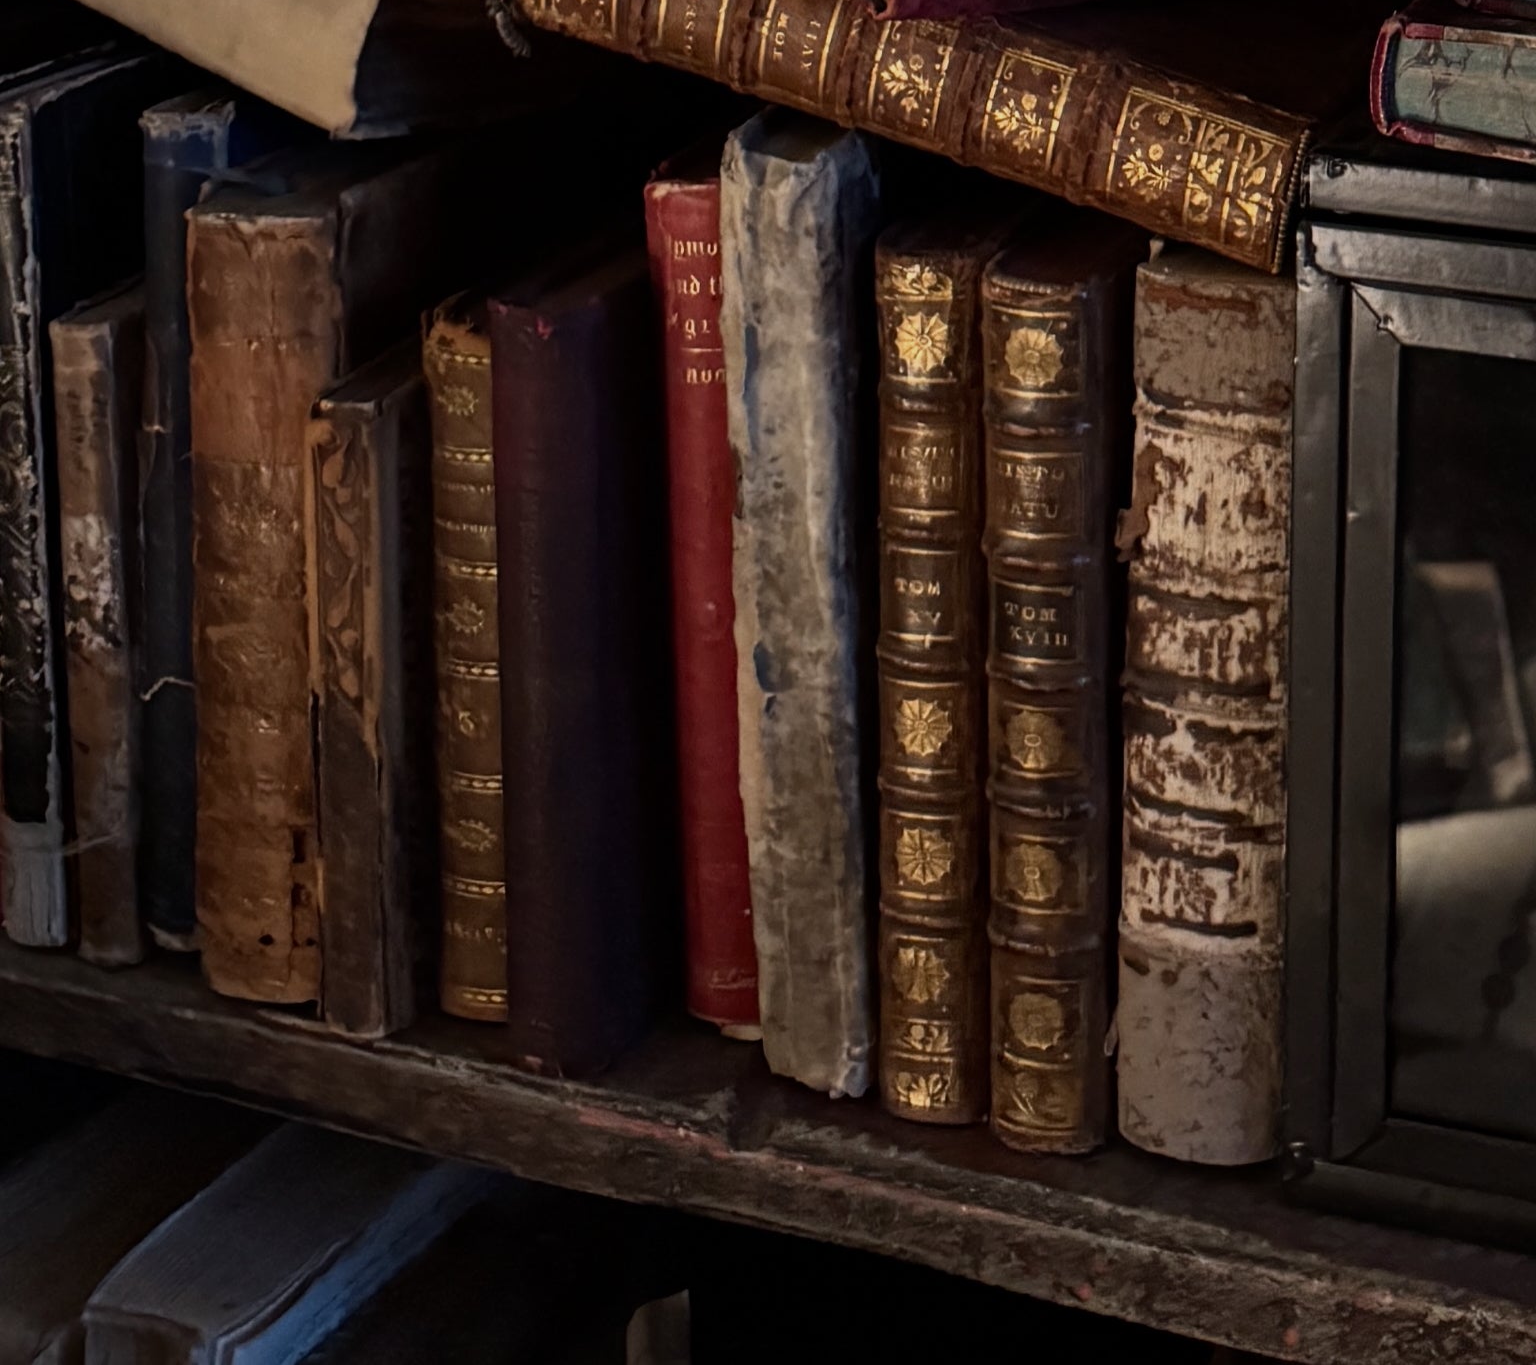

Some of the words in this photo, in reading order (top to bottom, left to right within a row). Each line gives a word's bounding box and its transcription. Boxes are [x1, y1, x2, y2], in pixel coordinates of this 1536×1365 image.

[772, 11, 790, 62] TOM
[893, 577, 942, 597] TOM
[1003, 601, 1058, 622] TOM
[1010, 625, 1069, 647] XVIII
